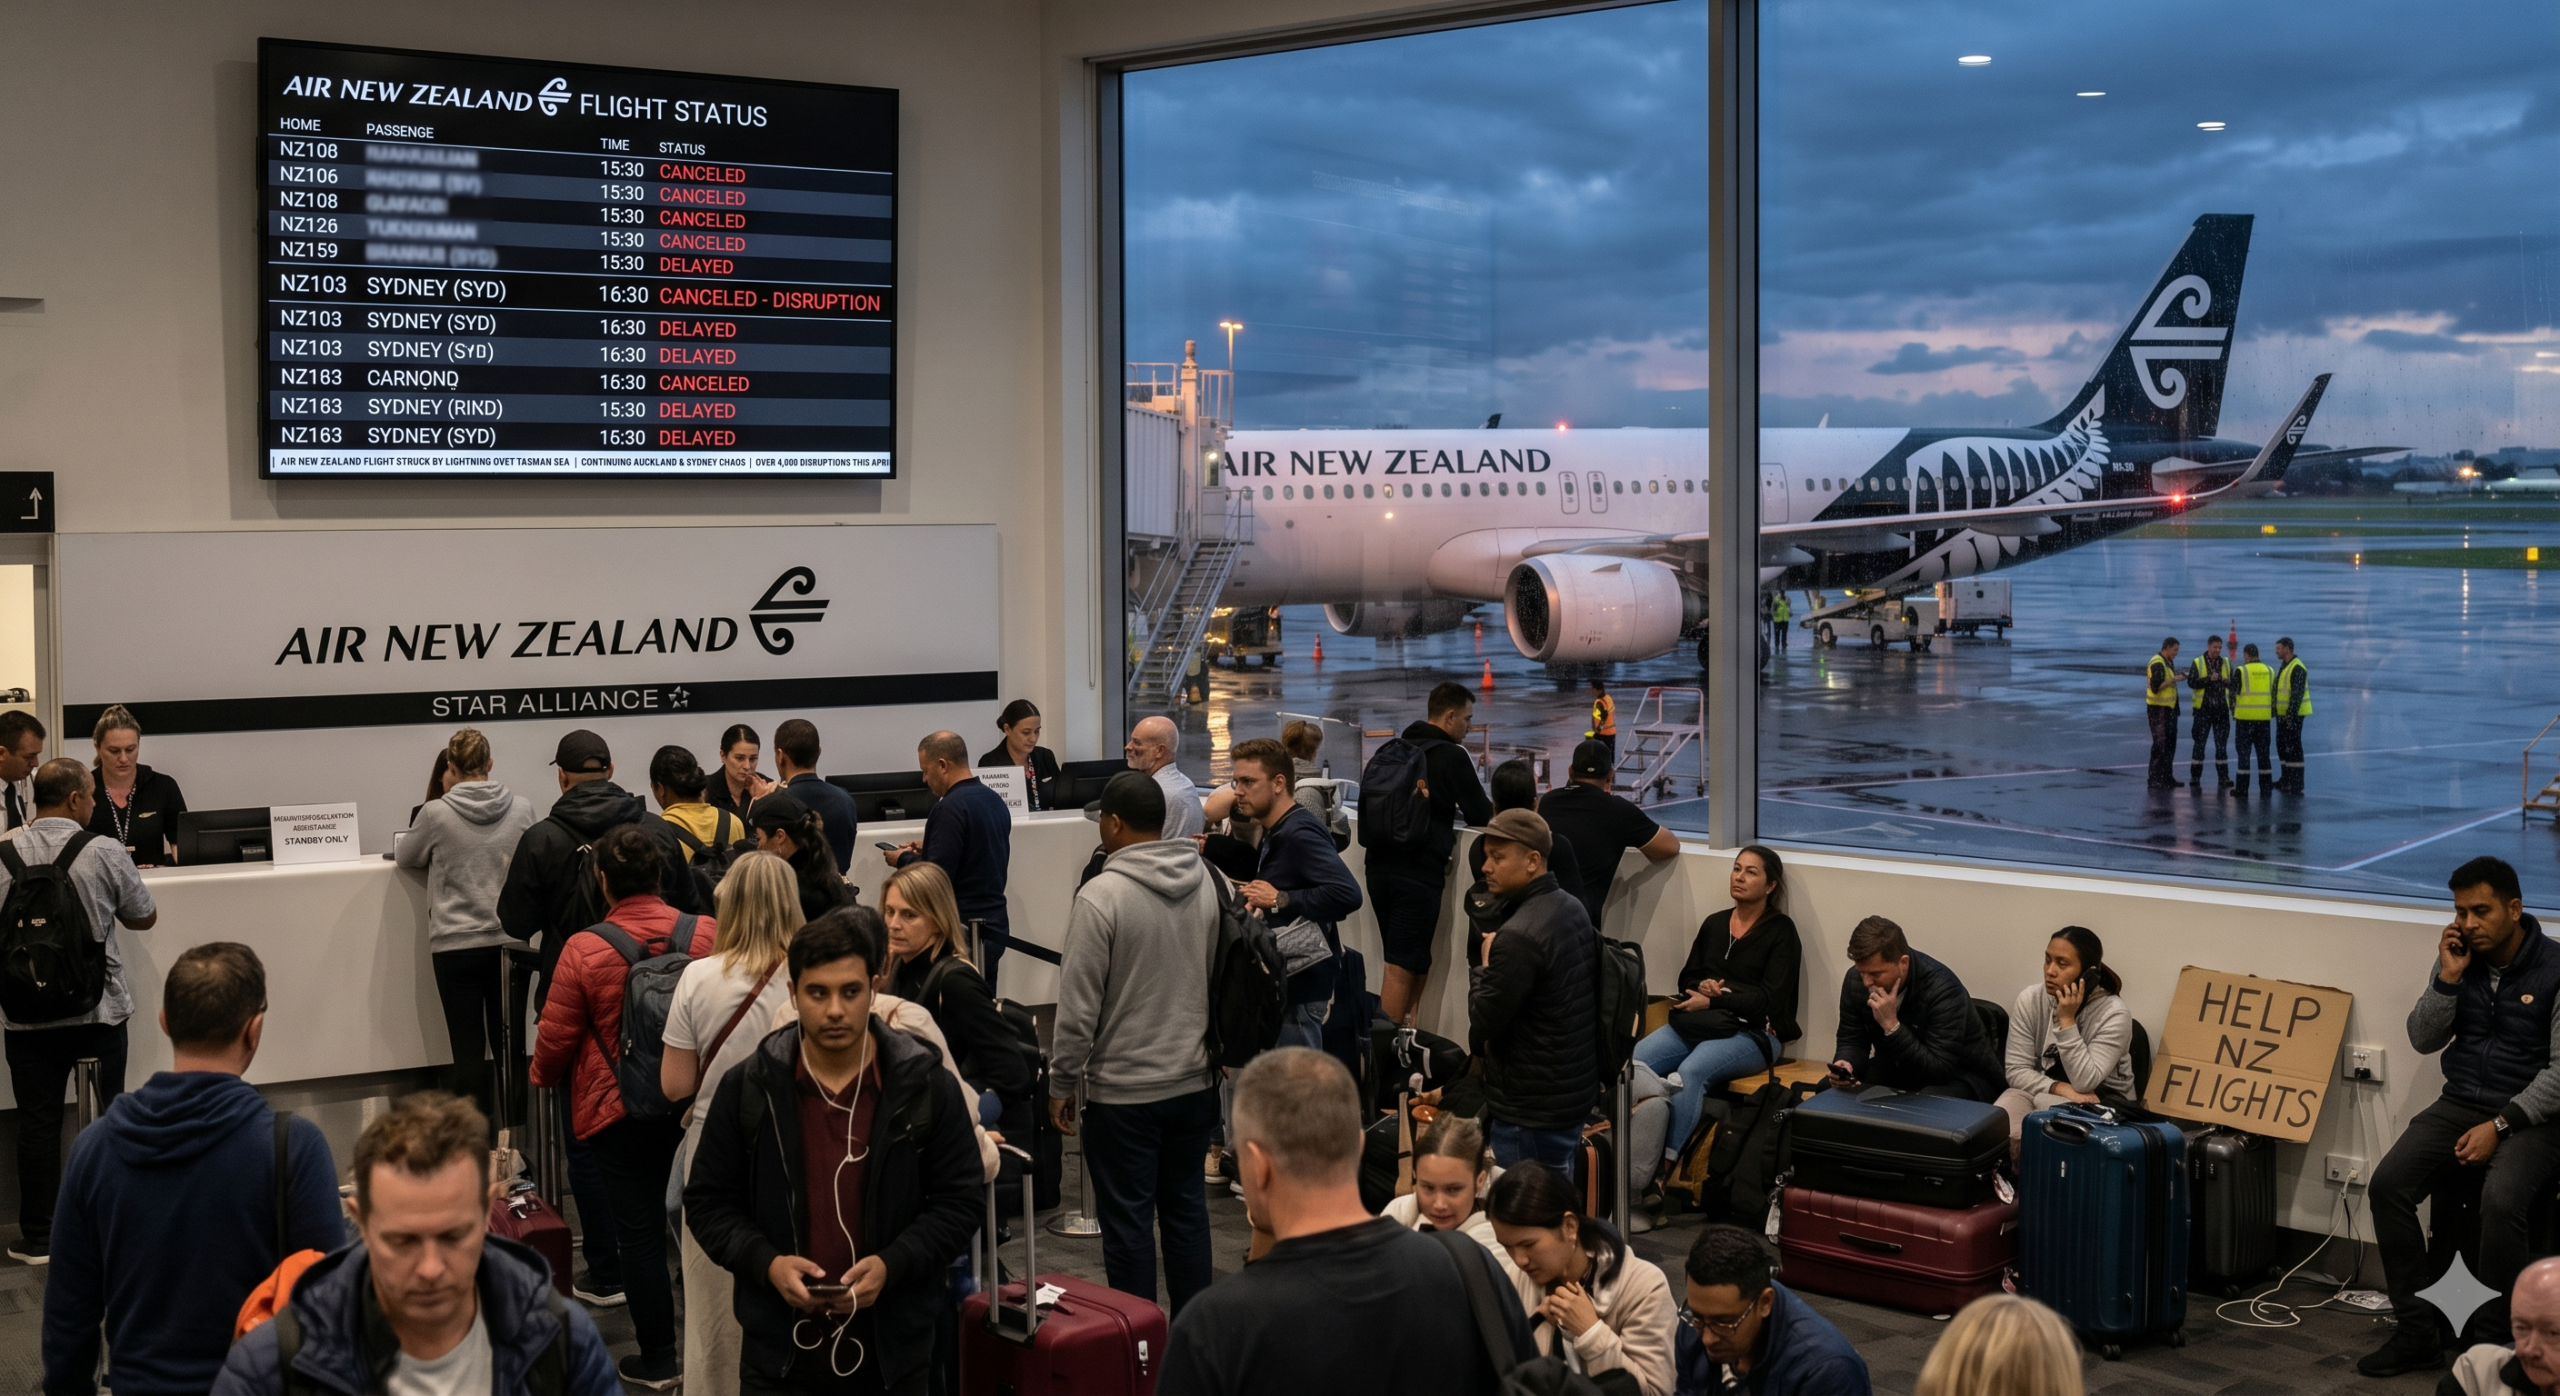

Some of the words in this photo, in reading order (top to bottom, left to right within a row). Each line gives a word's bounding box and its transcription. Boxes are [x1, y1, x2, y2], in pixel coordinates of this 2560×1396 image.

[282, 75, 332, 98] AIR
[340, 78, 405, 103] NEW
[408, 83, 533, 112] ZEALAND
[580, 93, 668, 120] FLIGHT
[674, 100, 767, 127] STATUS
[280, 117, 321, 132] HOME
[366, 122, 434, 139] PASSENGE
[600, 137, 630, 151] TIME
[658, 141, 706, 156] STATUS
[280, 140, 338, 159] NZ108
[600, 160, 644, 178] 15:30
[659, 163, 747, 184] CANCELED
[280, 165, 339, 184] NZ106
[600, 184, 644, 201] 15:30
[659, 186, 747, 207] CANCELED
[280, 190, 338, 209] NZ108
[600, 207, 645, 224] 15:30
[659, 209, 746, 229] CANCELED
[280, 215, 338, 234] NZ126
[600, 231, 645, 248] 15:30
[659, 233, 746, 252] CANCELED
[280, 241, 338, 258] NZ159
[600, 254, 644, 271] 15:30
[659, 256, 734, 275] DELAYED
[280, 273, 347, 294] NZ103
[366, 276, 448, 297] SYDNEY
[453, 278, 506, 303] (SYD)
[599, 285, 649, 304] 16:30
[659, 286, 758, 308] CANCELED
[772, 291, 881, 312] DISRUPTION
[281, 309, 342, 327] NZ103
[367, 311, 443, 330] SYDNEY
[447, 313, 496, 336] (SYD)
[600, 318, 646, 336] 16:30
[659, 319, 737, 339] DELAYED
[281, 338, 342, 357] NZ103
[367, 340, 443, 358] SYDNEY
[600, 346, 646, 363] 16:30
[659, 347, 737, 365] DELAYED
[659, 374, 750, 392] CANCELED
[368, 398, 443, 415] SYDNEY
[600, 401, 646, 418] 15:30
[659, 401, 737, 419] DELAYED
[281, 426, 343, 444] NZ163
[367, 427, 443, 444] SYDNEY
[447, 427, 496, 448] (SYD)
[658, 429, 736, 447] DELAYED
[281, 457, 296, 466] AIR
[298, 457, 318, 466] NEW
[320, 457, 361, 466] ZEALAND
[363, 457, 395, 466] FLIGHT
[396, 457, 430, 466] STRUCK
[432, 457, 443, 466] BY
[445, 457, 491, 466] LIGHTNING
[493, 457, 517, 466] OVET
[517, 457, 552, 466] TASMAN
[554, 457, 570, 466] SEA
[581, 457, 632, 467] CONTINUING
[633, 457, 677, 467] AUCKLAND
[679, 457, 685, 467] &
[686, 457, 717, 467] SYDNEY
[719, 457, 746, 467] CHAOS
[755, 458, 776, 467] OVER
[777, 458, 798, 468] 4,000
[800, 458, 851, 467] DISRUPTIONS
[852, 458, 870, 467] THIS
[1290, 450, 1373, 476] NEW
[1384, 448, 1551, 475] ZEALAND
[274, 626, 367, 666] AIR
[383, 622, 502, 662] NEW
[510, 616, 739, 658] ZEALAND
[432, 694, 507, 717] STAR
[518, 689, 660, 713] ALLIANCE
[284, 836, 323, 846] STANDBY
[324, 835, 349, 844] ONLY
[2198, 982, 2322, 1038] HELP
[2214, 1034, 2280, 1074] NZ
[2160, 1063, 2318, 1128] FLIGHTS
